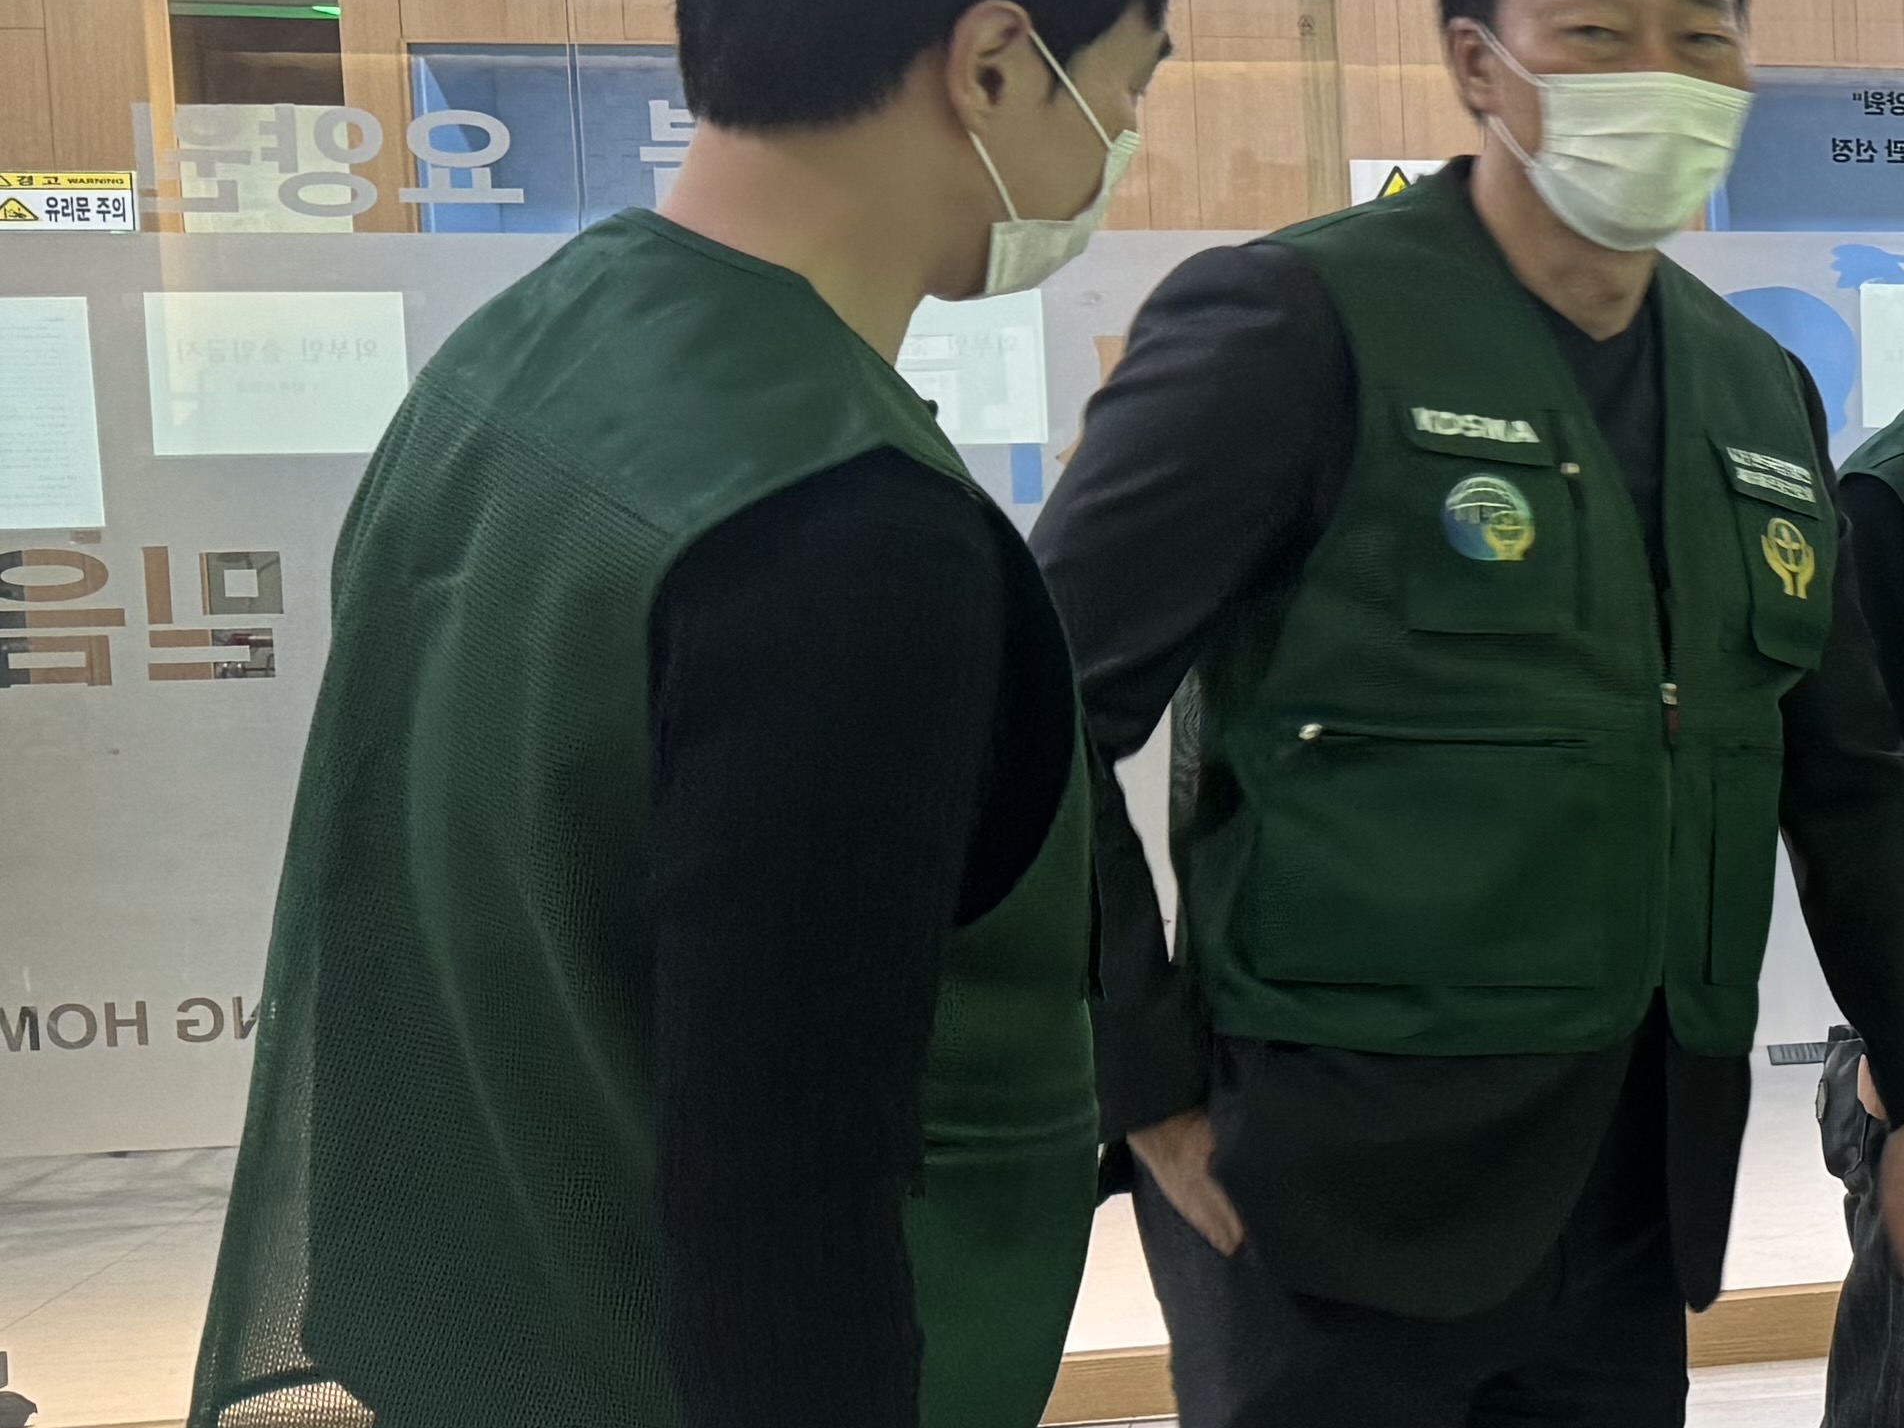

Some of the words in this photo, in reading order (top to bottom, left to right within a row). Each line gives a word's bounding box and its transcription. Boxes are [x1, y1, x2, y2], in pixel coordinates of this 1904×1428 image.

[67, 177, 125, 185] WARNING
[45, 196, 91, 223] 유리문
[96, 196, 126, 223] 주의
